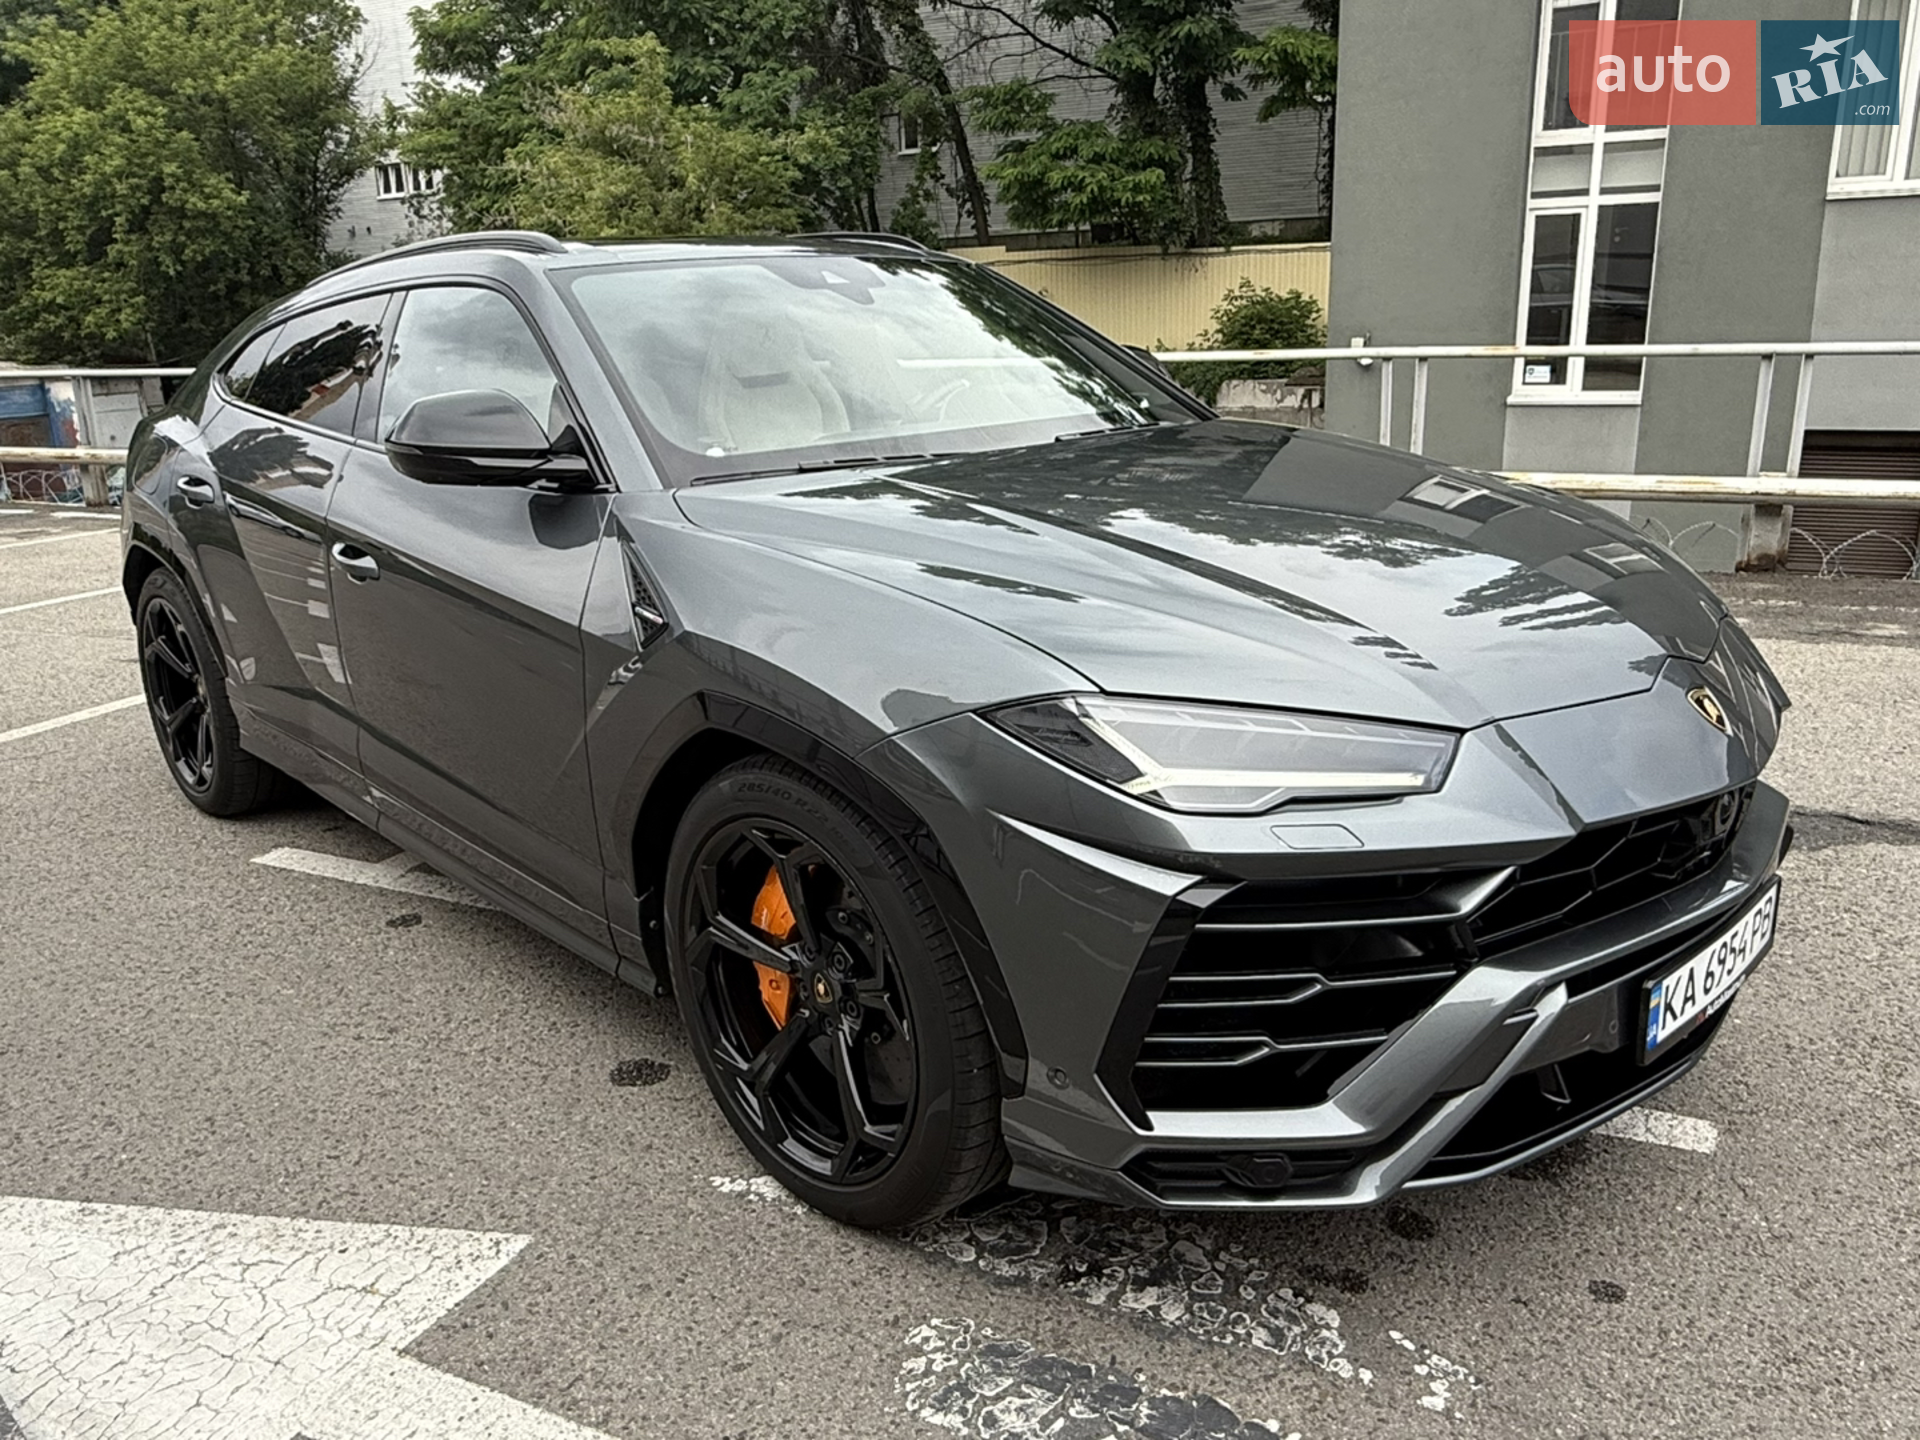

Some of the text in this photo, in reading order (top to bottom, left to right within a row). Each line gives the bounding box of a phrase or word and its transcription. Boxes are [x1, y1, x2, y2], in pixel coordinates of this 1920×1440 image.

[738, 782, 792, 801] 285/40
[1661, 966, 1696, 1031] KA
[1703, 920, 1749, 996] 6954
